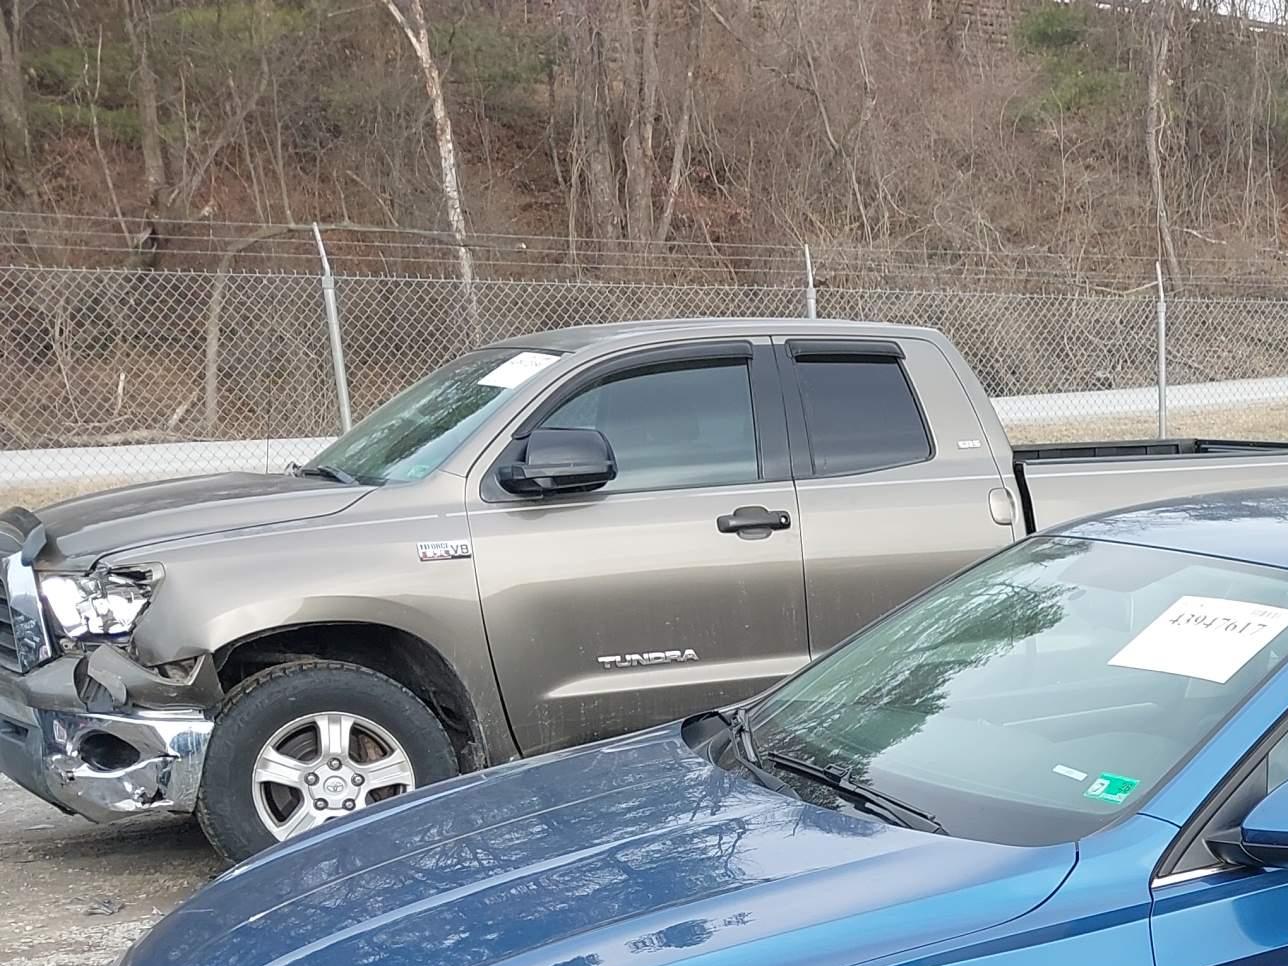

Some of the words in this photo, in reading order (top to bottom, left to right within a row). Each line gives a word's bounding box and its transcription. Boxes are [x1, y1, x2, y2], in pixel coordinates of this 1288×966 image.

[450, 543, 469, 554] V8
[1168, 612, 1268, 637] 43947617
[598, 648, 700, 669] TUNDRA
